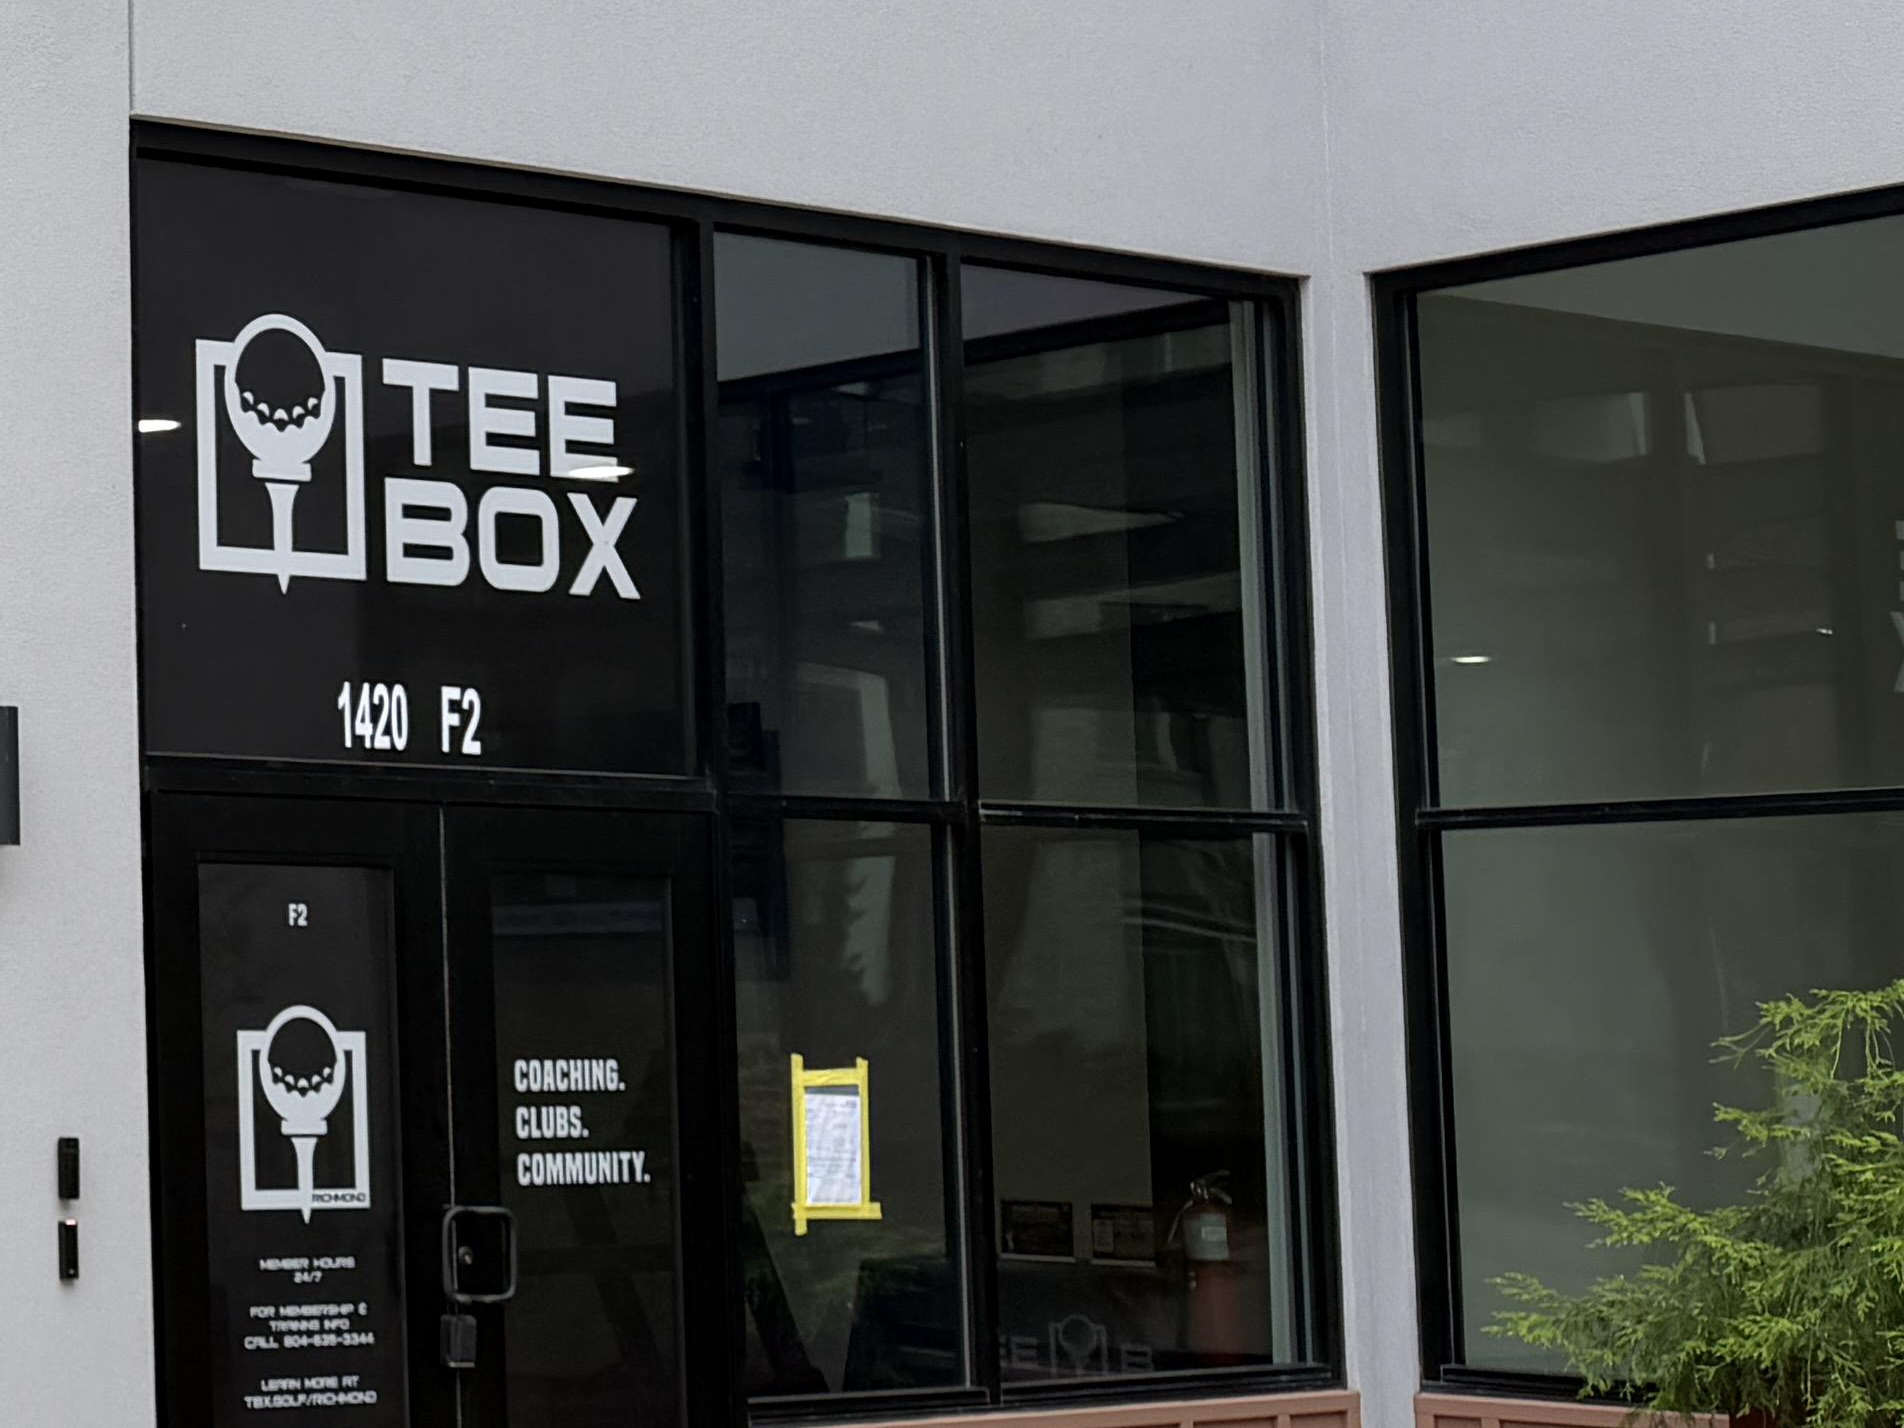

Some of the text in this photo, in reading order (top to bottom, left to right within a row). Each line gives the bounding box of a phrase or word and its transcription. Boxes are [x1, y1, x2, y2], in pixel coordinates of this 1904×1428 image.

[382, 357, 619, 483] TEE
[384, 476, 640, 600] BOX
[337, 681, 482, 755] 1420 F2
[288, 903, 308, 926] F2
[514, 1058, 626, 1092] COACHING.
[515, 1105, 589, 1139] CLUBS.
[517, 1150, 651, 1186] COMMUNITY.
[259, 1256, 356, 1270] MEMBER HOURS
[249, 1306, 276, 1319] FOR
[244, 1335, 280, 1350] CALL
[260, 1375, 360, 1392] LEARN MORE AT
